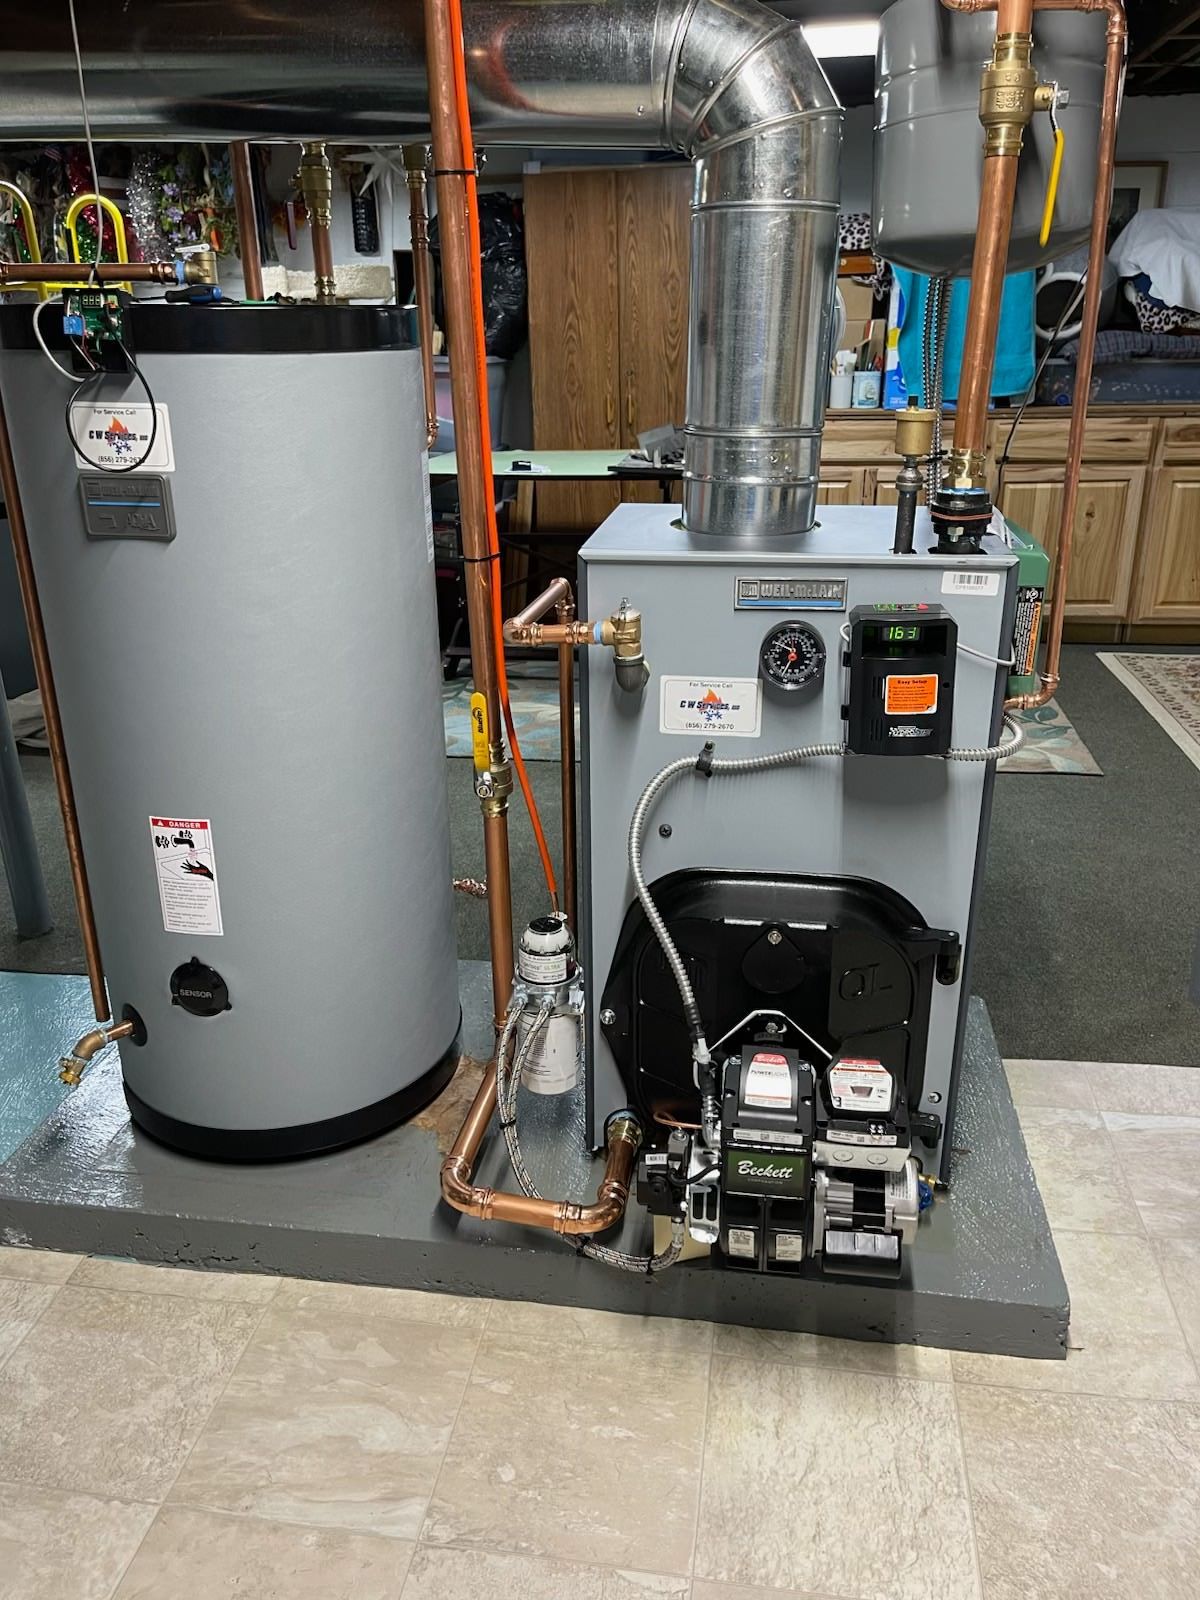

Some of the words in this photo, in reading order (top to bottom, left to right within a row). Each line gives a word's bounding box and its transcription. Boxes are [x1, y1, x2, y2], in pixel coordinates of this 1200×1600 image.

[88, 430, 95, 440] C
[95, 430, 103, 440] W
[115, 456, 142, 464] 279-267
[687, 700, 696, 709] W
[704, 722, 735, 730] 279-2670
[168, 821, 201, 829] DANGER
[179, 989, 213, 999] SENSOR
[737, 1160, 793, 1179] Beckett
